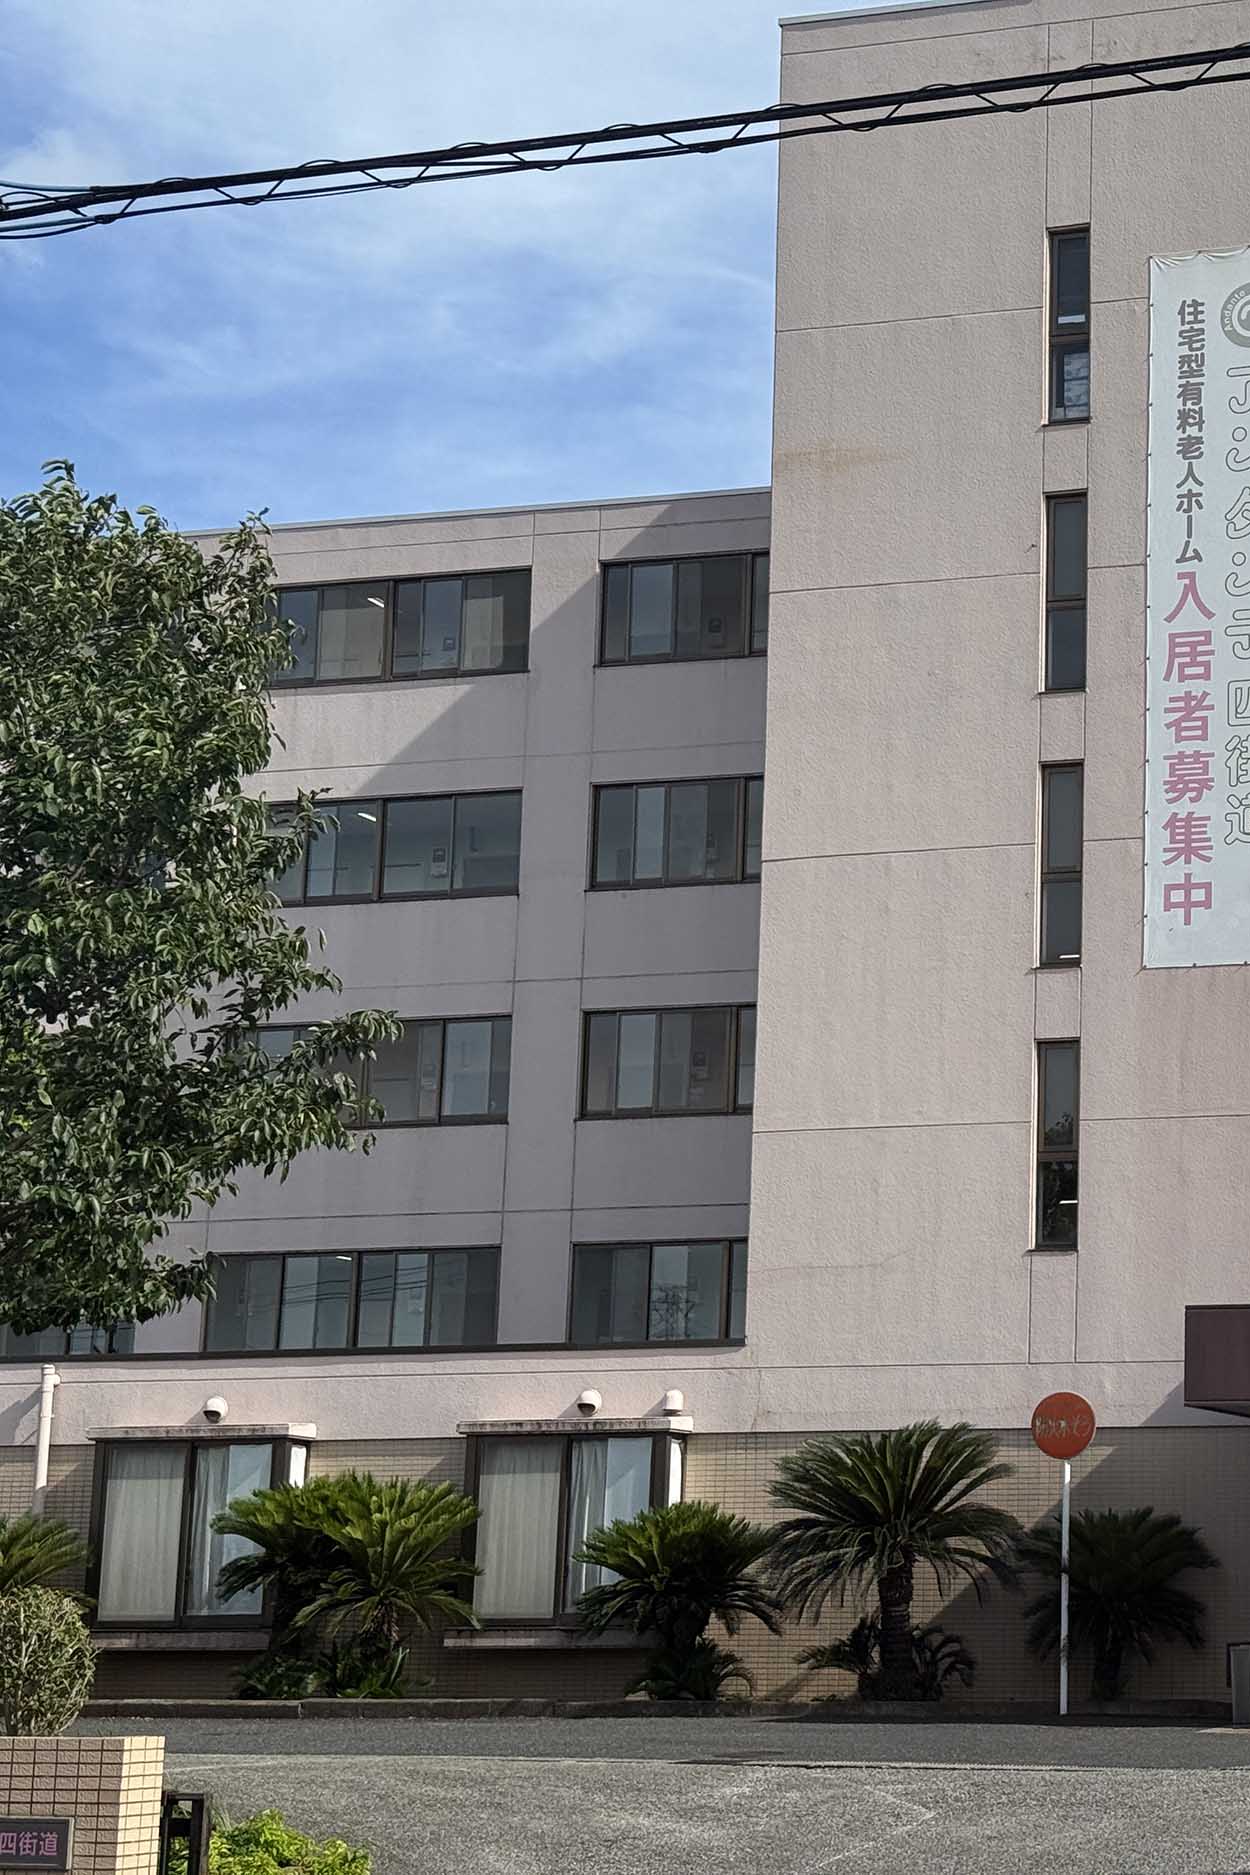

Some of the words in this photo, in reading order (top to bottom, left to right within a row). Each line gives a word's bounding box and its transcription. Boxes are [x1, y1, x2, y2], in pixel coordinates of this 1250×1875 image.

[1223, 290, 1246, 331] Andante
[1175, 298, 1206, 565] 住宅型有料老人ホーム
[1162, 571, 1216, 927] 入居者募集中
[0, 1831, 58, 1856] 四街道
